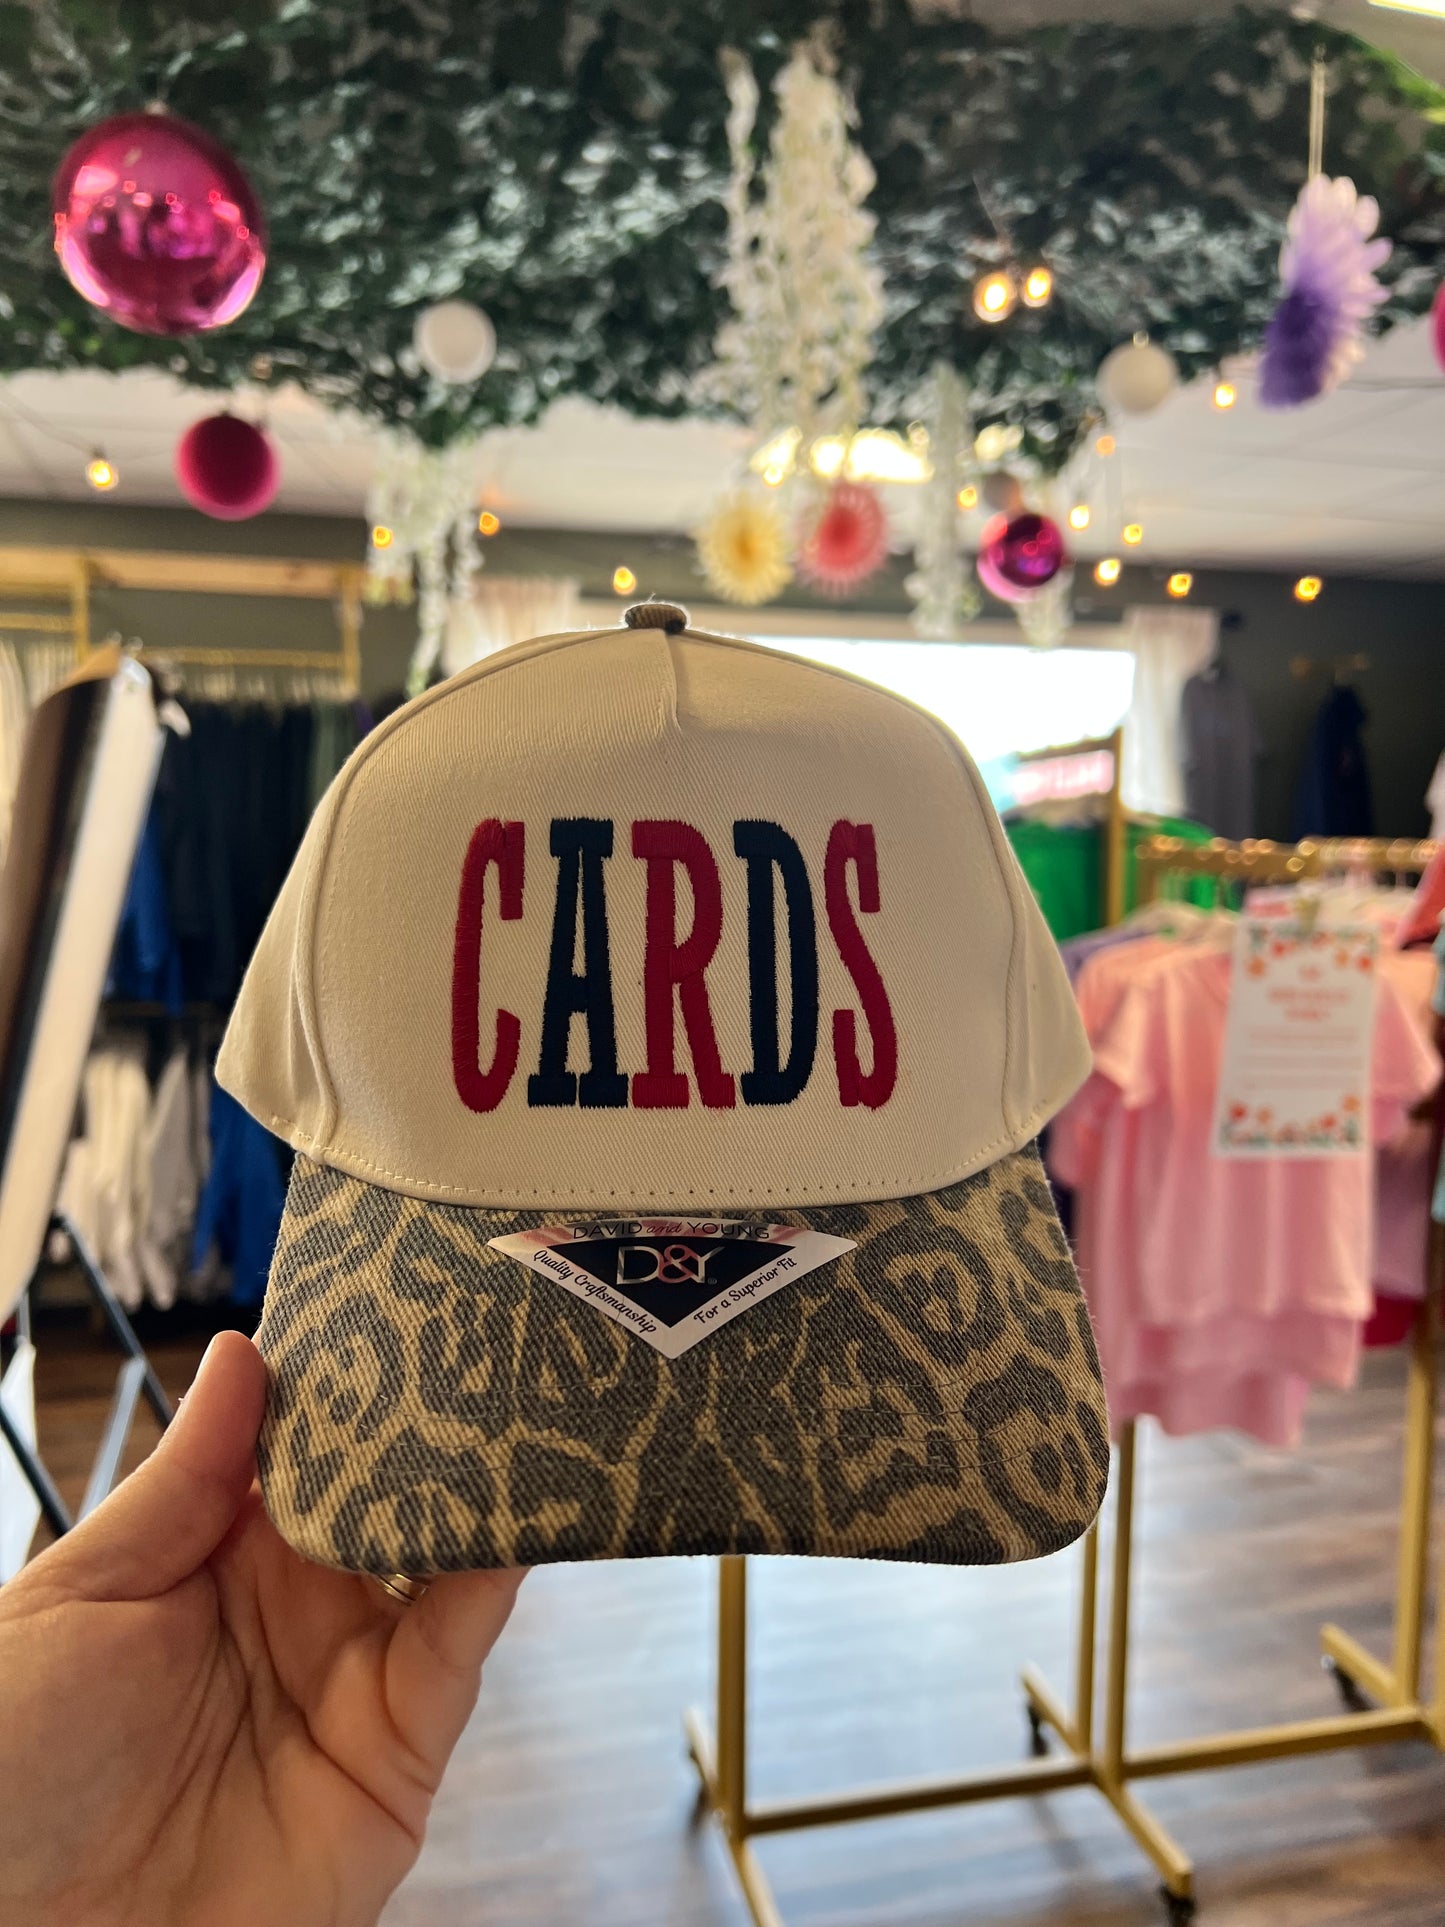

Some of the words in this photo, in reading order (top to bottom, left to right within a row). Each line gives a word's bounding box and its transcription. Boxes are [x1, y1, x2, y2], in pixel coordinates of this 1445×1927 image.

[452, 818, 898, 1113] CARDS
[573, 1222, 643, 1239] DAVID
[646, 1221, 682, 1234] and
[687, 1221, 770, 1239] YOUNG
[533, 1249, 574, 1280] Quality
[574, 1274, 657, 1333] Craftsmanship
[693, 1305, 719, 1324] For
[720, 1299, 731, 1309] a
[728, 1267, 779, 1301] Superior
[776, 1257, 798, 1271] Fit
